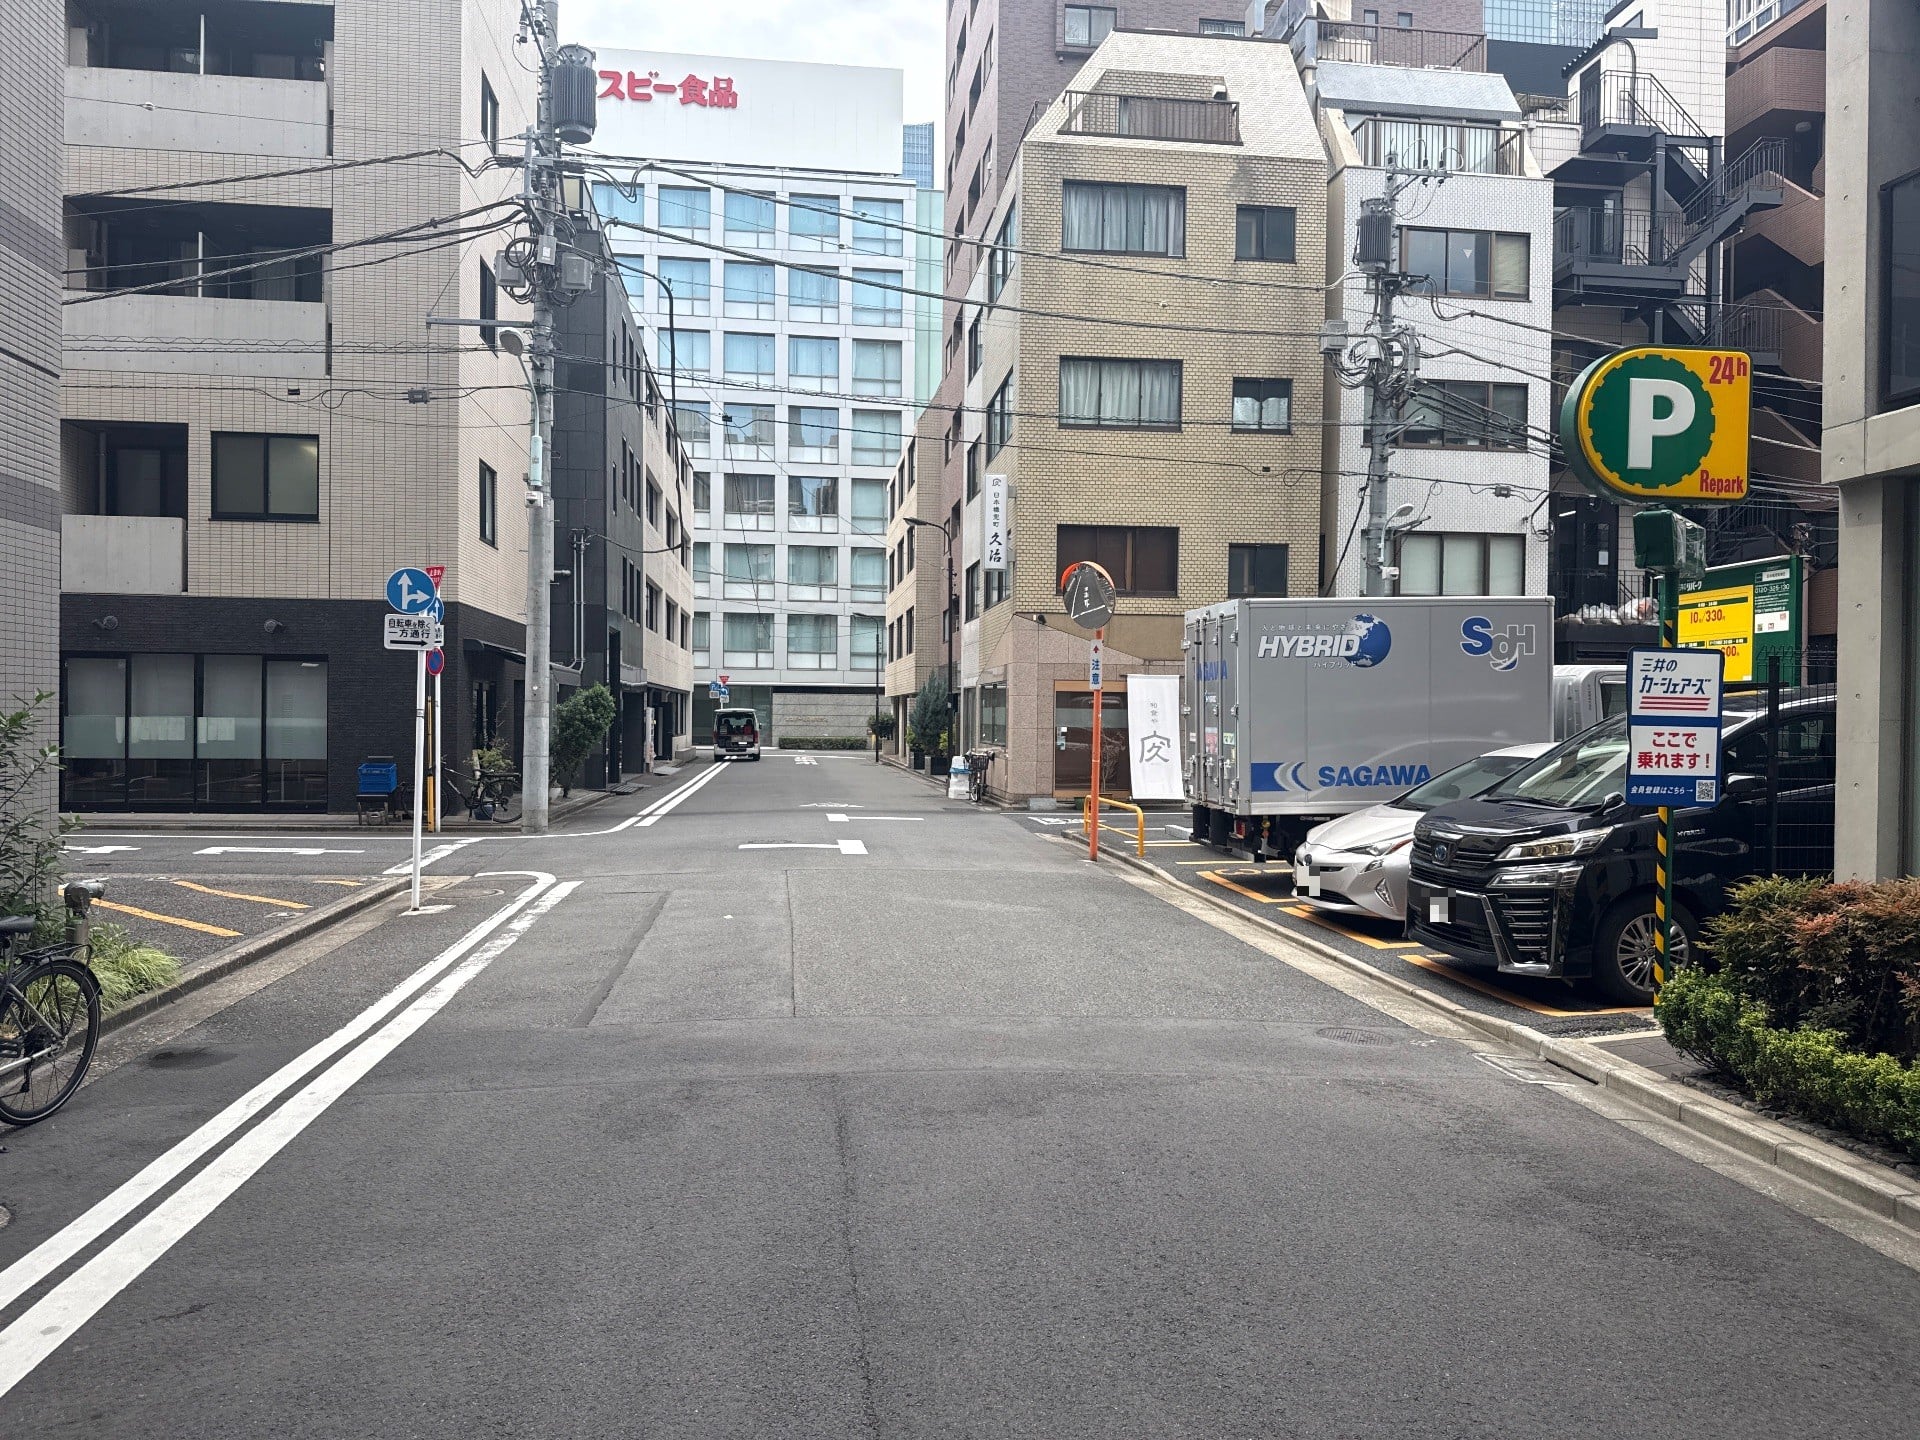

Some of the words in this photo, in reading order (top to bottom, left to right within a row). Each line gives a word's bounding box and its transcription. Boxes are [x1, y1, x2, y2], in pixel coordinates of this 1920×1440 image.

[1627, 377, 1696, 470] P
[1700, 469, 1744, 497] Repark
[989, 532, 1003, 563] 久治
[388, 618, 431, 629] 自転車を除く
[388, 629, 431, 639] 一方通行
[1257, 634, 1361, 658] HYBRID
[1091, 658, 1101, 685] 注意
[1197, 659, 1228, 681] AGAWA
[1640, 658, 1677, 673] 三井の
[1639, 675, 1712, 695] カーシェアーズ
[1652, 732, 1697, 748] ここで
[1318, 764, 1431, 787] SAGAWA
[1630, 785, 1685, 795] 会員登録はこちら
